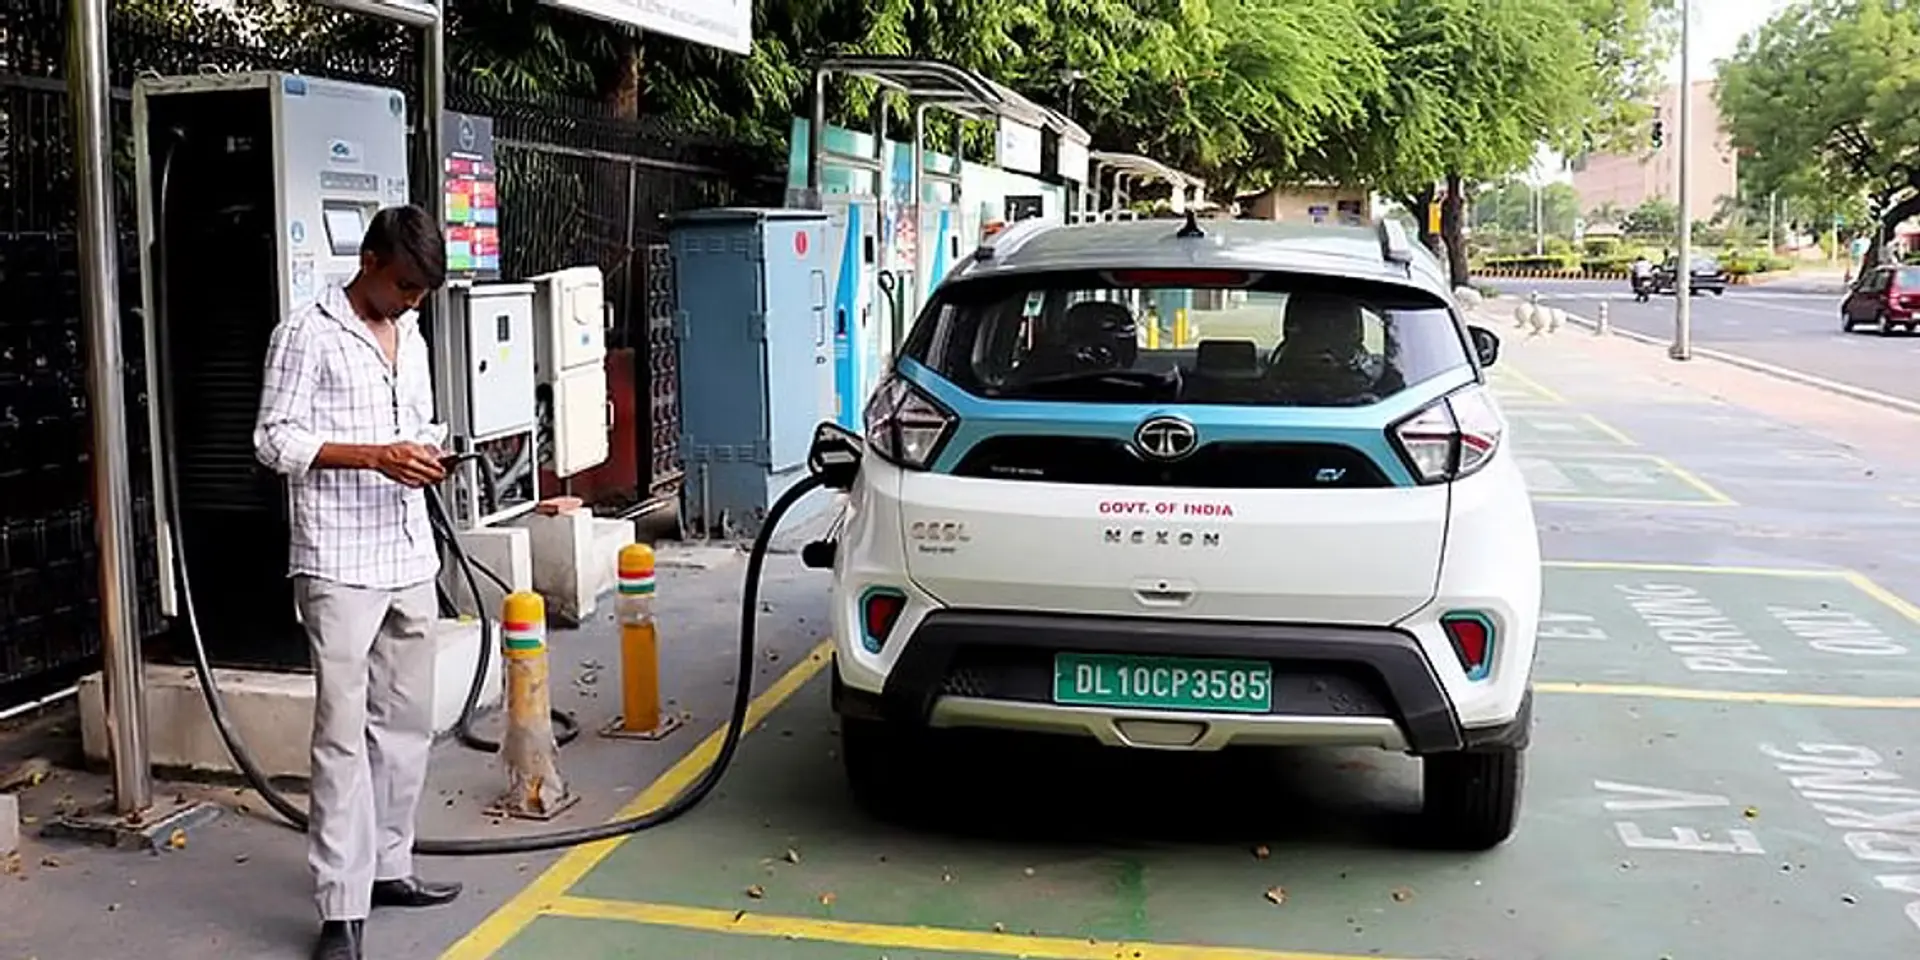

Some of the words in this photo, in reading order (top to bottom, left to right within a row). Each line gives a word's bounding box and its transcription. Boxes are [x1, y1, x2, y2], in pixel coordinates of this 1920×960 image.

[1099, 501, 1150, 516] GOVT.
[1155, 502, 1178, 515] OF
[1183, 503, 1234, 517] INDIA
[1104, 528, 1220, 546] NEXON
[1614, 583, 1789, 674] PARKING
[1594, 779, 1767, 855] EV
